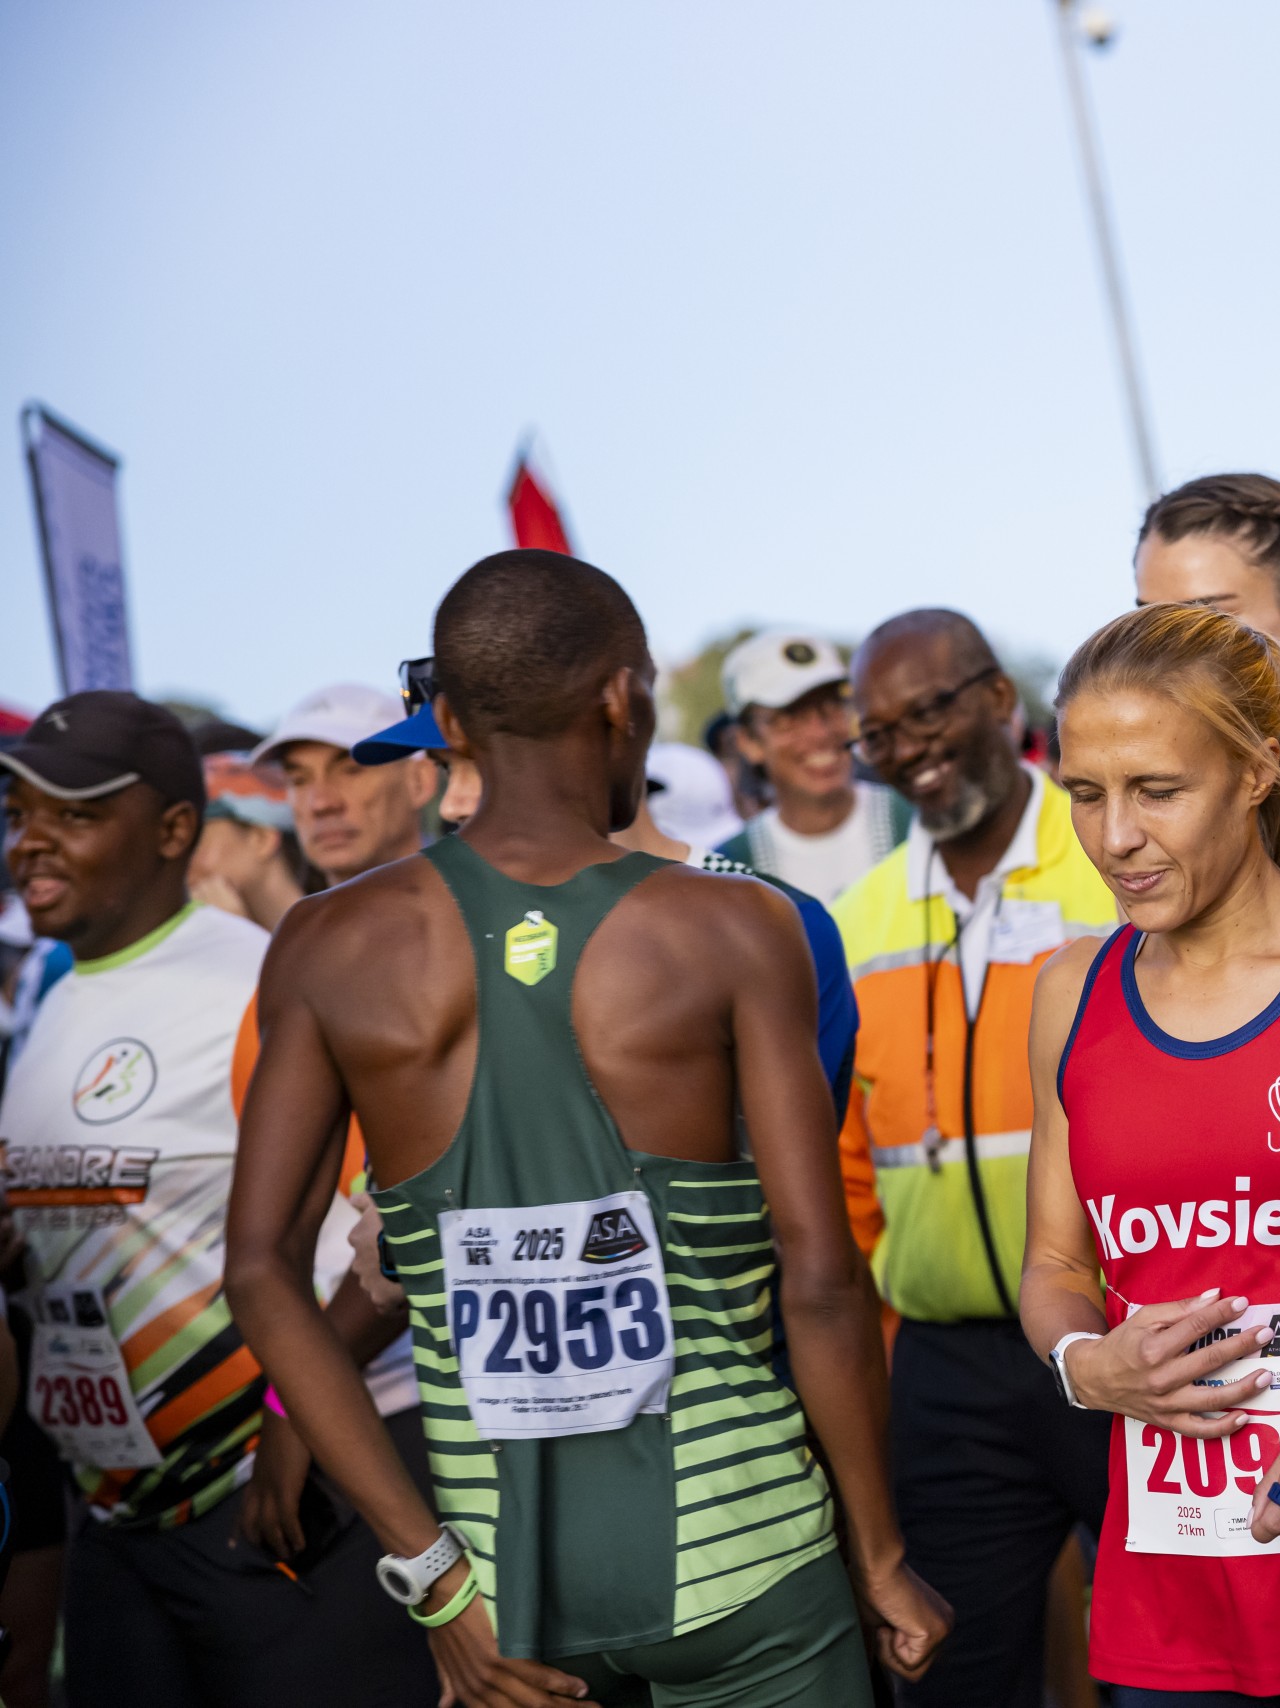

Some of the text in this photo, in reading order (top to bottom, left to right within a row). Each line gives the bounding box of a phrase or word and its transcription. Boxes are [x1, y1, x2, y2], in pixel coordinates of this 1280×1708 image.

[512, 1227, 564, 1261] 2025
[589, 1214, 638, 1244] ASA
[34, 1375, 129, 1426] 2389
[1177, 1506, 1202, 1519] 2025
[1177, 1523, 1205, 1536] 21km
